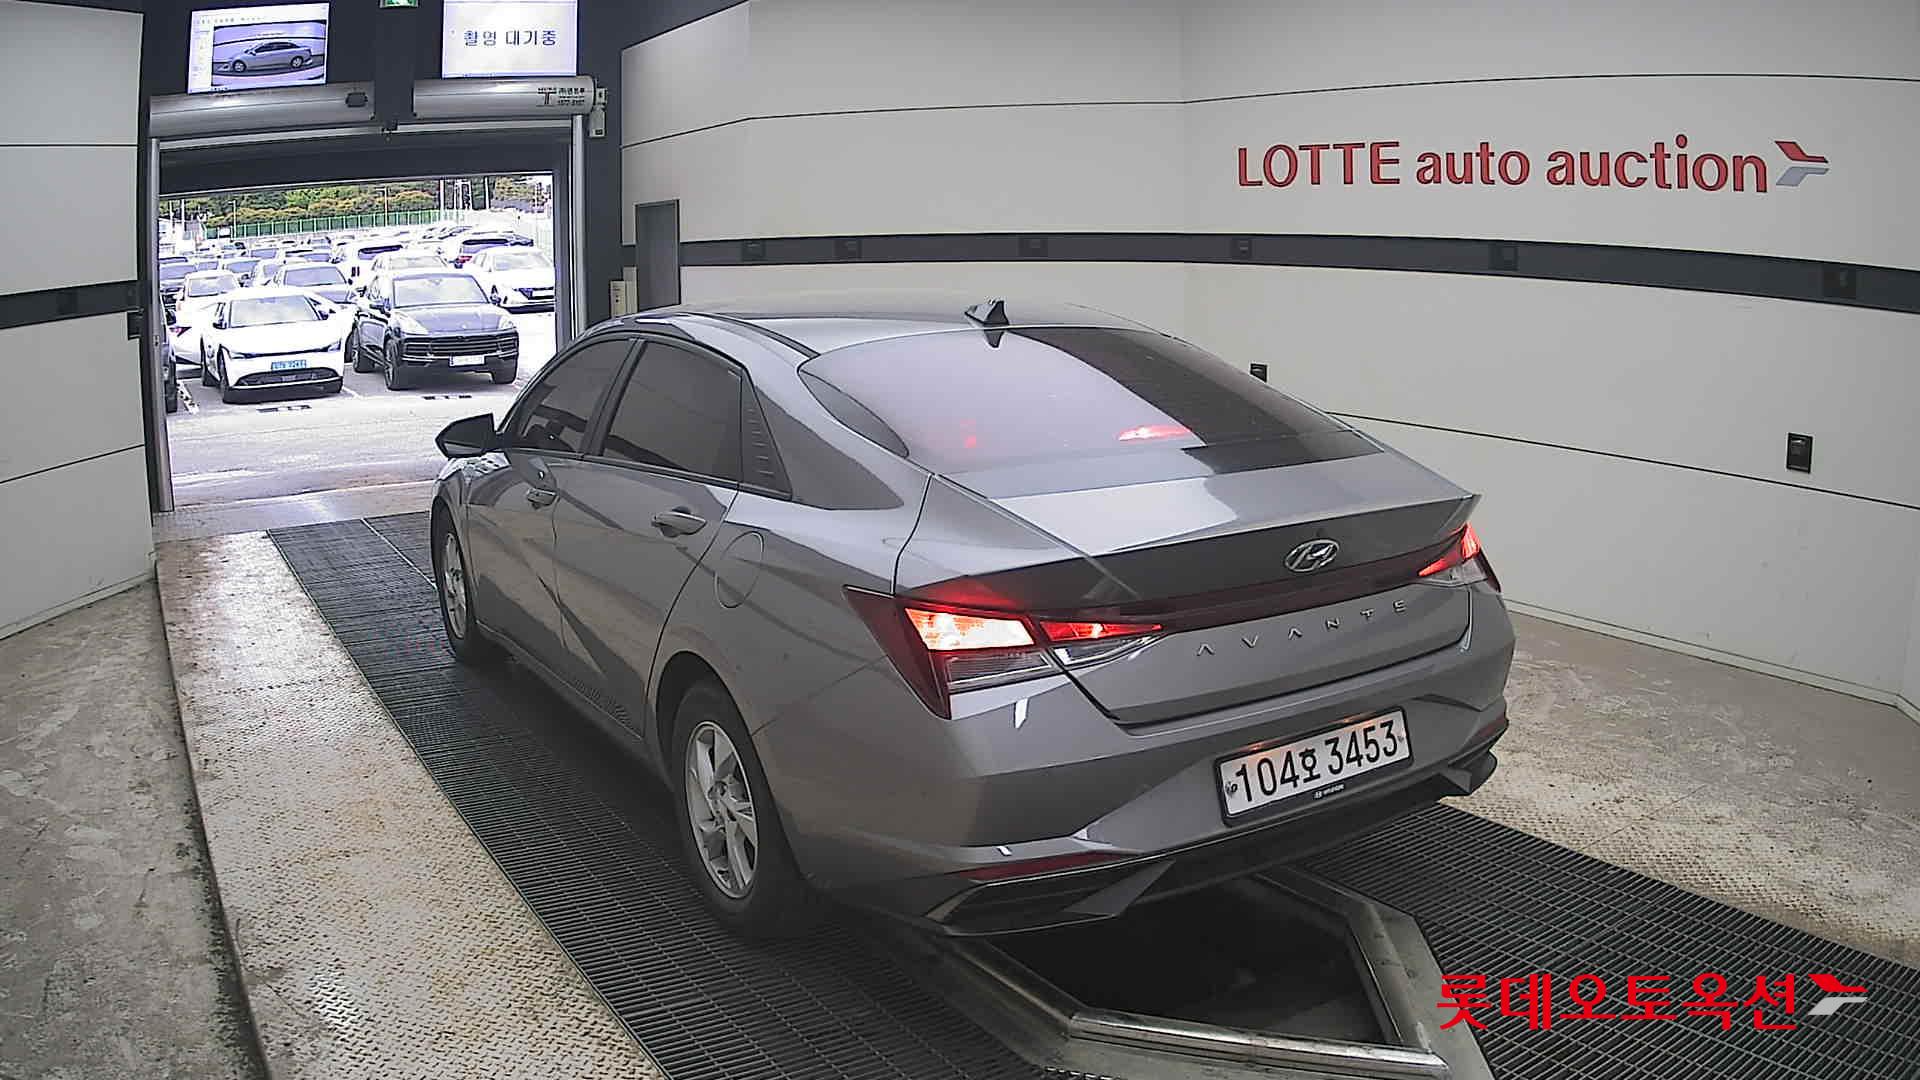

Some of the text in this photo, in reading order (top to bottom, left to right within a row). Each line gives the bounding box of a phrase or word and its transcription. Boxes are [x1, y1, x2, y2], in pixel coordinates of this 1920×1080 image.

[505, 29, 557, 46] 대기중
[1238, 134, 1768, 194] LOTTE auto auction
[1197, 600, 1407, 656] AVANTE
